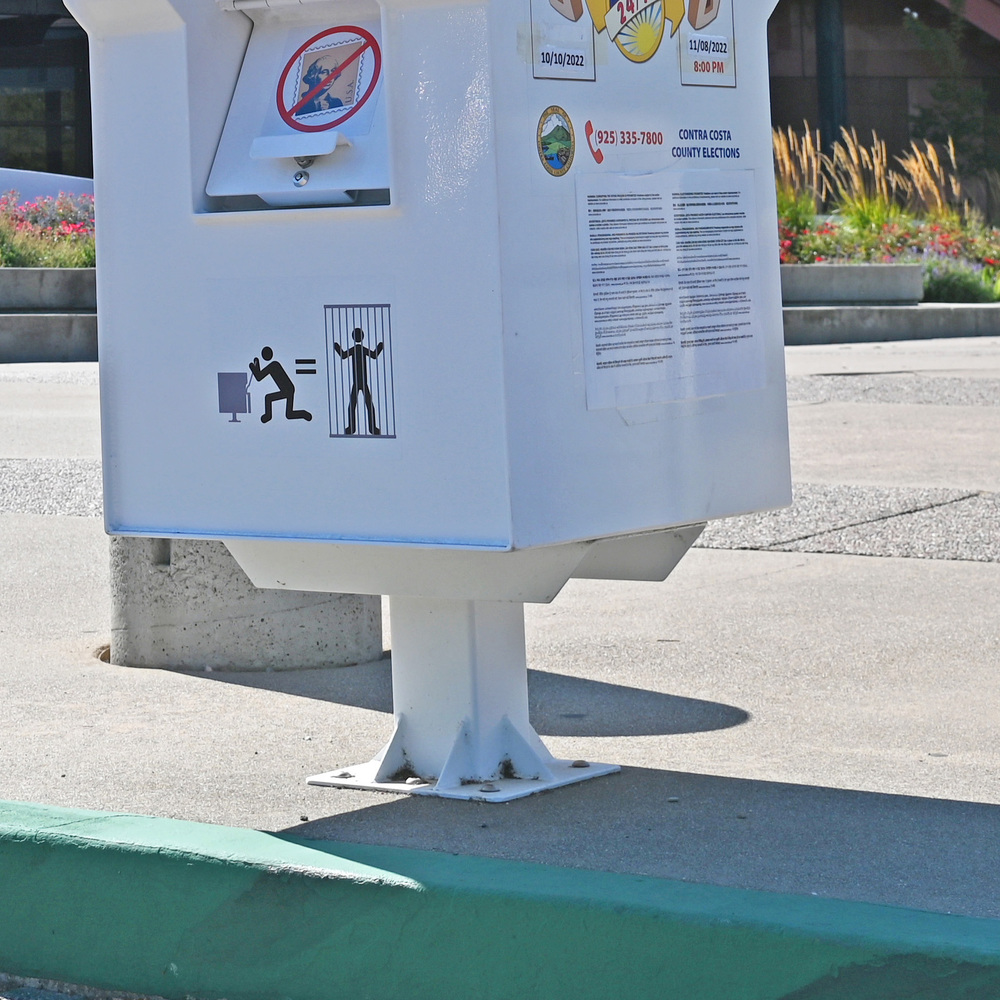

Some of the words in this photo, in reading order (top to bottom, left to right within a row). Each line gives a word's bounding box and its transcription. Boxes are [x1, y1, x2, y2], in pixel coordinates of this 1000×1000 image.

[688, 39, 728, 54] 11/08/2022
[540, 52, 585, 67] 10/10/2022
[693, 61, 711, 73] 8:00
[711, 61, 725, 74] PM
[594, 129, 618, 146] (925)
[619, 130, 664, 146] 335-7800
[678, 128, 708, 141] CONTRA
[709, 129, 732, 141] COSTA
[671, 146, 701, 158] COUNTY
[702, 147, 741, 159] ELECTIONS
